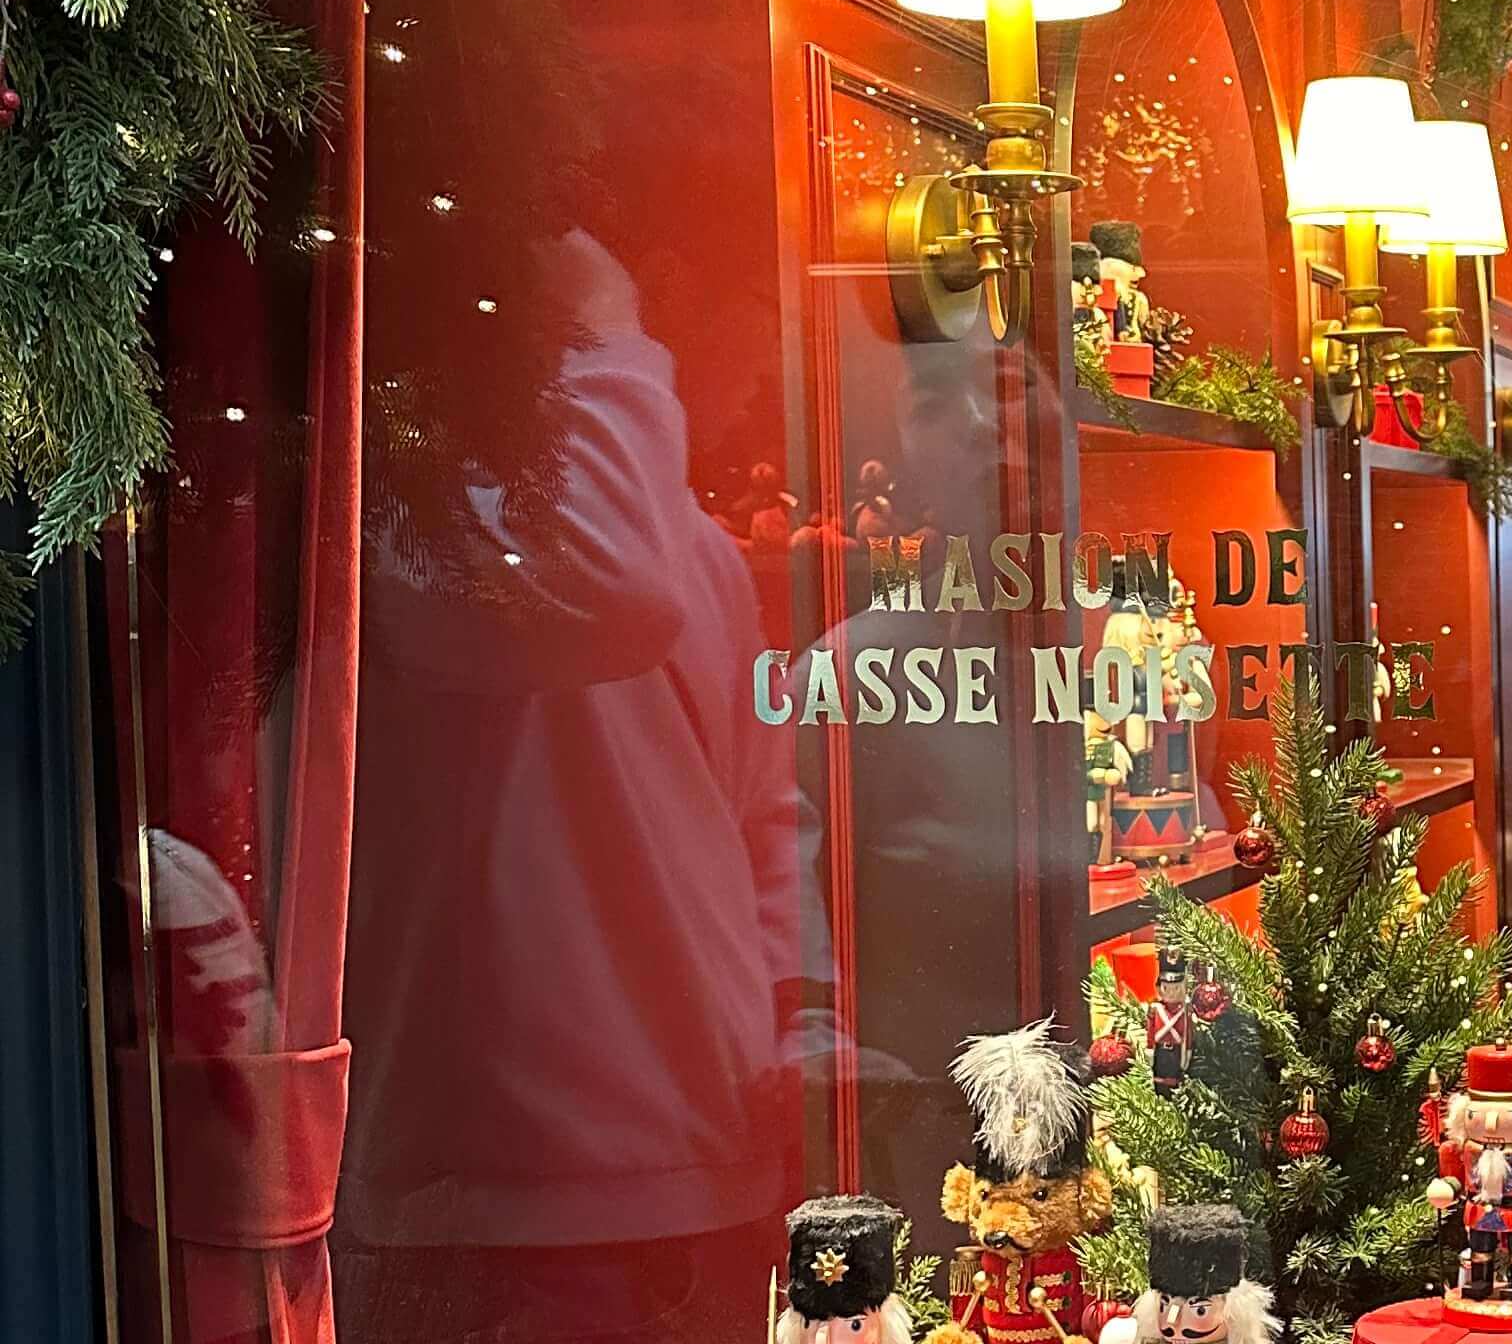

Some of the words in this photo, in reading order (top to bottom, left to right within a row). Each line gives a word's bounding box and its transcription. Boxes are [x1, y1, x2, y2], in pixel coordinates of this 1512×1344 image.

[868, 532, 1173, 613] MASION
[1211, 528, 1310, 608] DE
[753, 646, 998, 726] CASSE
[1030, 641, 1437, 726] NOISETTE
